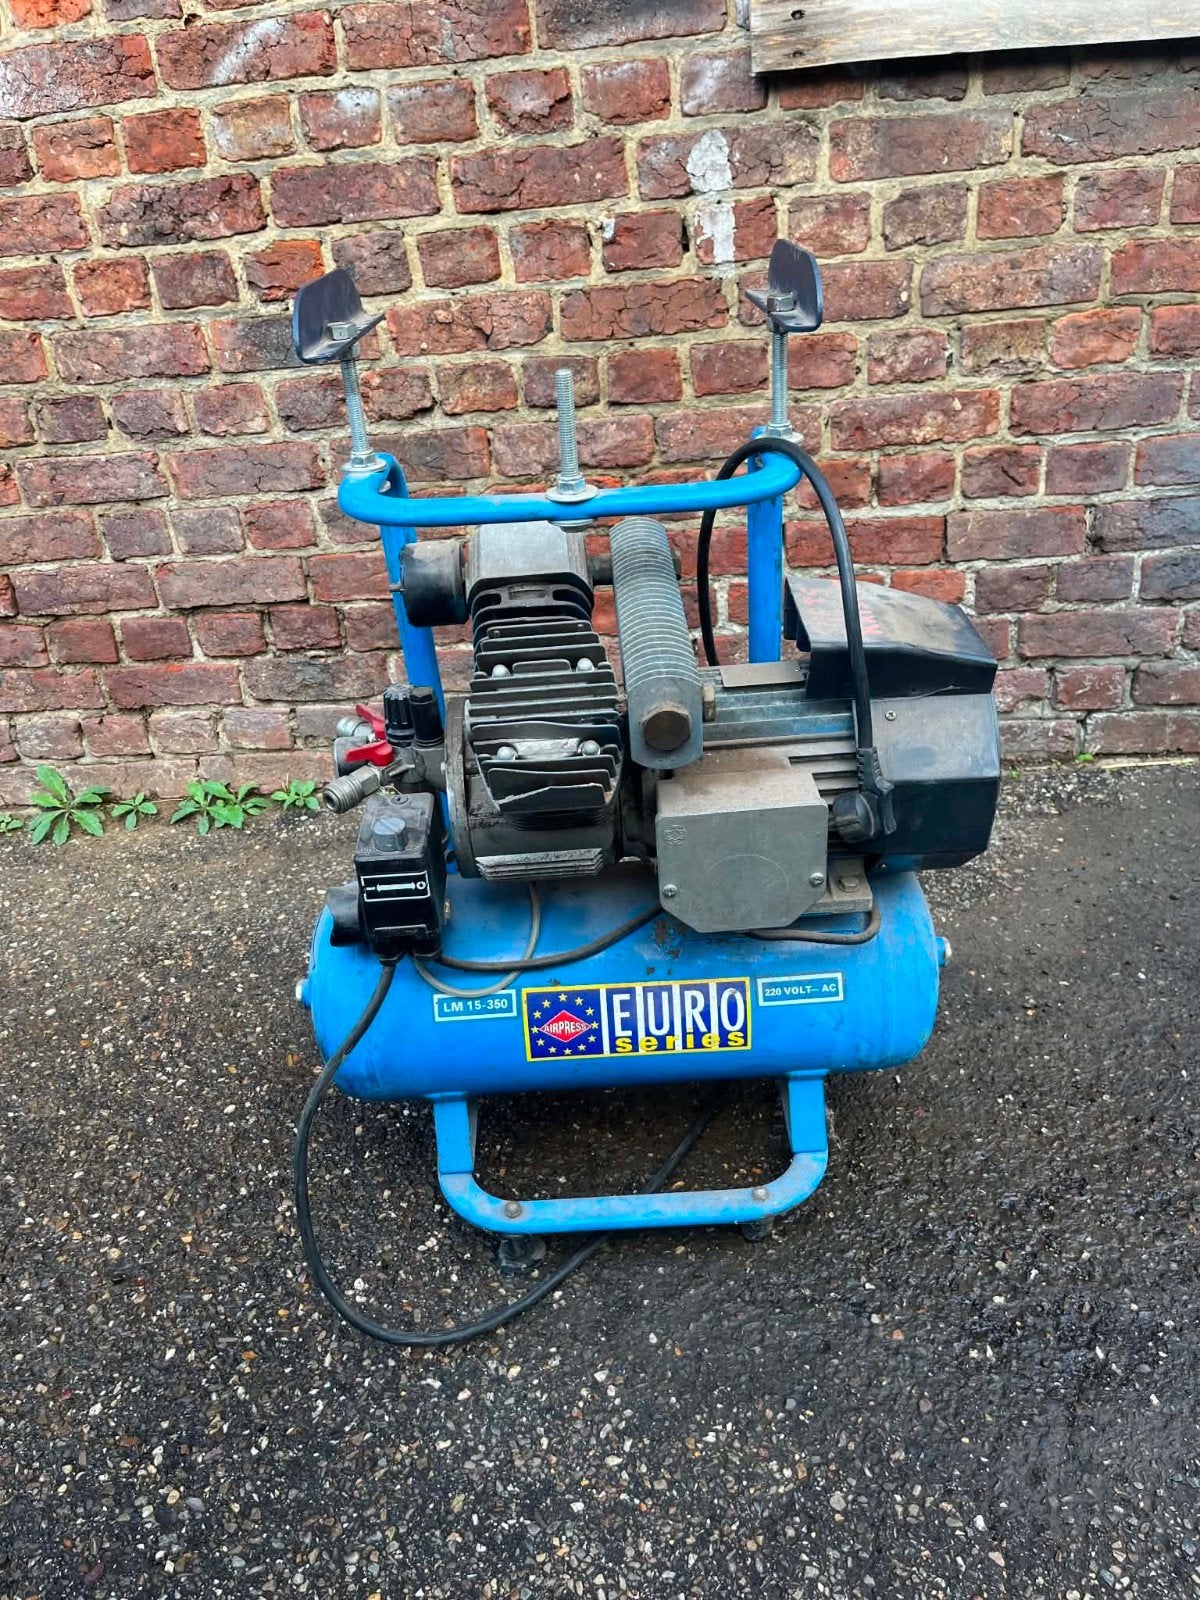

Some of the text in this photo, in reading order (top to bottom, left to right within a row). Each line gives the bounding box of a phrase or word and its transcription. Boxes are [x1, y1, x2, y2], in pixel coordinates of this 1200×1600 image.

[764, 987, 782, 997] 220
[821, 983, 837, 993] AC
[443, 998, 508, 1013] LM 15-350
[612, 987, 745, 1037] EURO
[543, 1022, 587, 1036] AIRPRESS
[615, 1027, 745, 1053] series
